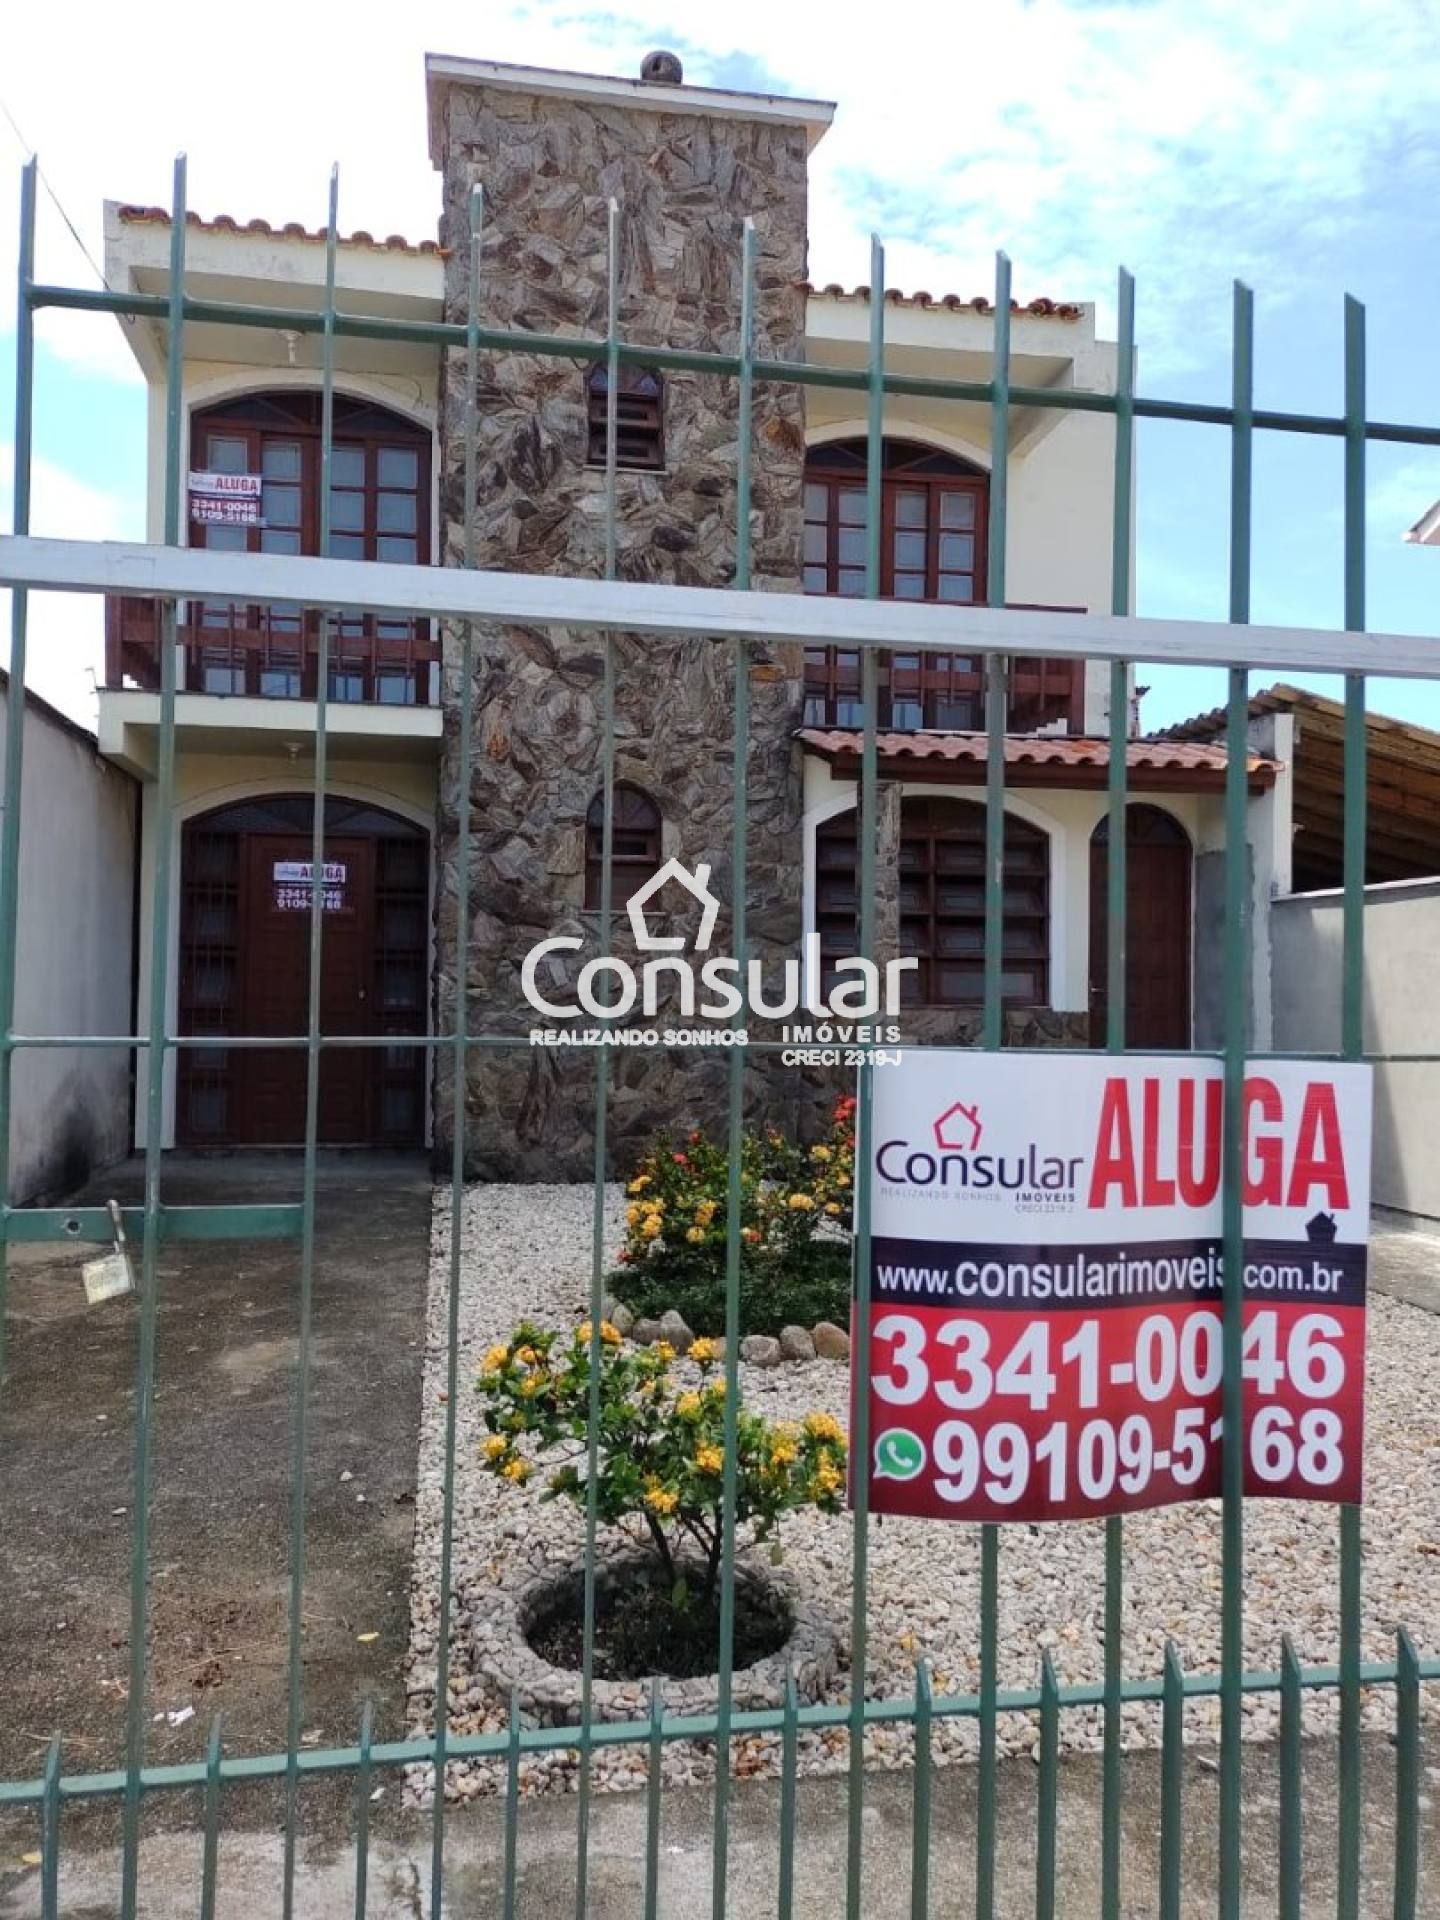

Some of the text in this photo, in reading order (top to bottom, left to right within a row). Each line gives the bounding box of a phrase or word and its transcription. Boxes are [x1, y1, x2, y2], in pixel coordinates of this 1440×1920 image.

[216, 477, 257, 491] ALUGA
[277, 888, 342, 900] 3341-046
[301, 866, 342, 881] AGA
[876, 1140, 1084, 1189] Consular
[1087, 1076, 1350, 1210] ALUGA
[877, 1248, 1344, 1298] www.consularimoveicom.br
[871, 1309, 1345, 1411] 3341-0046
